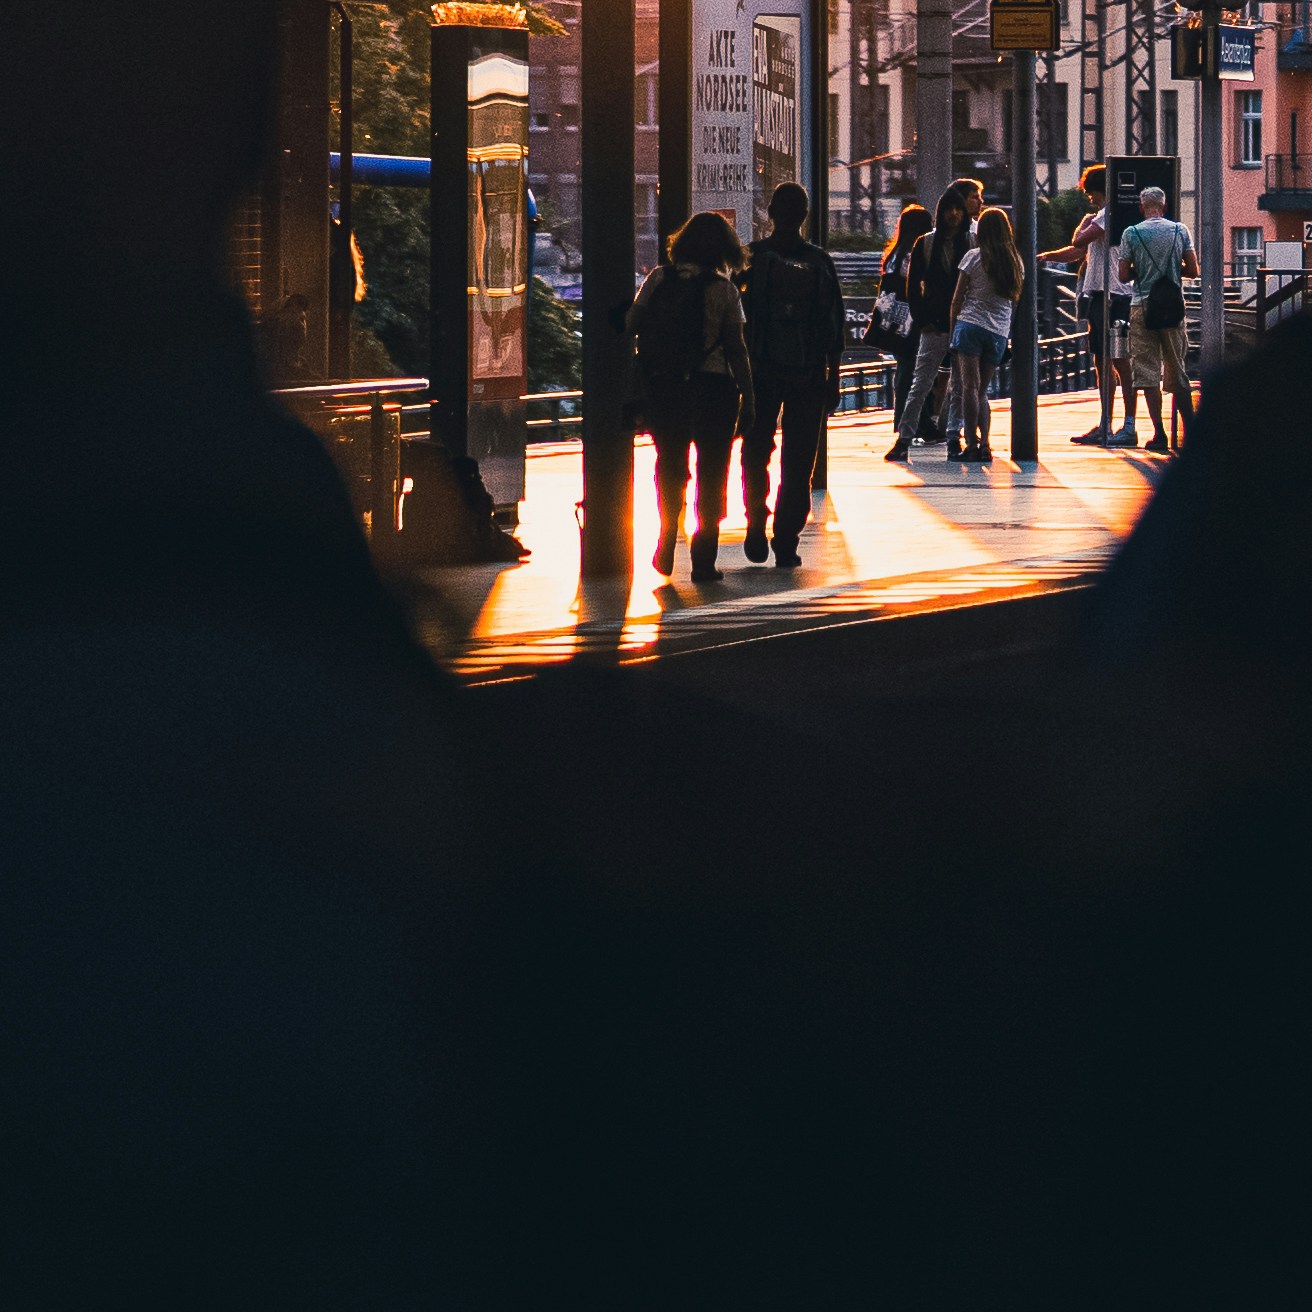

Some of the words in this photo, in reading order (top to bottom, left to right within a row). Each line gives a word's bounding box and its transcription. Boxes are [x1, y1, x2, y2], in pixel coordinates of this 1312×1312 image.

[709, 30, 736, 68] AKTE
[696, 74, 747, 112] NORDSEE
[703, 126, 717, 154] DIE
[718, 126, 741, 154] NEUE
